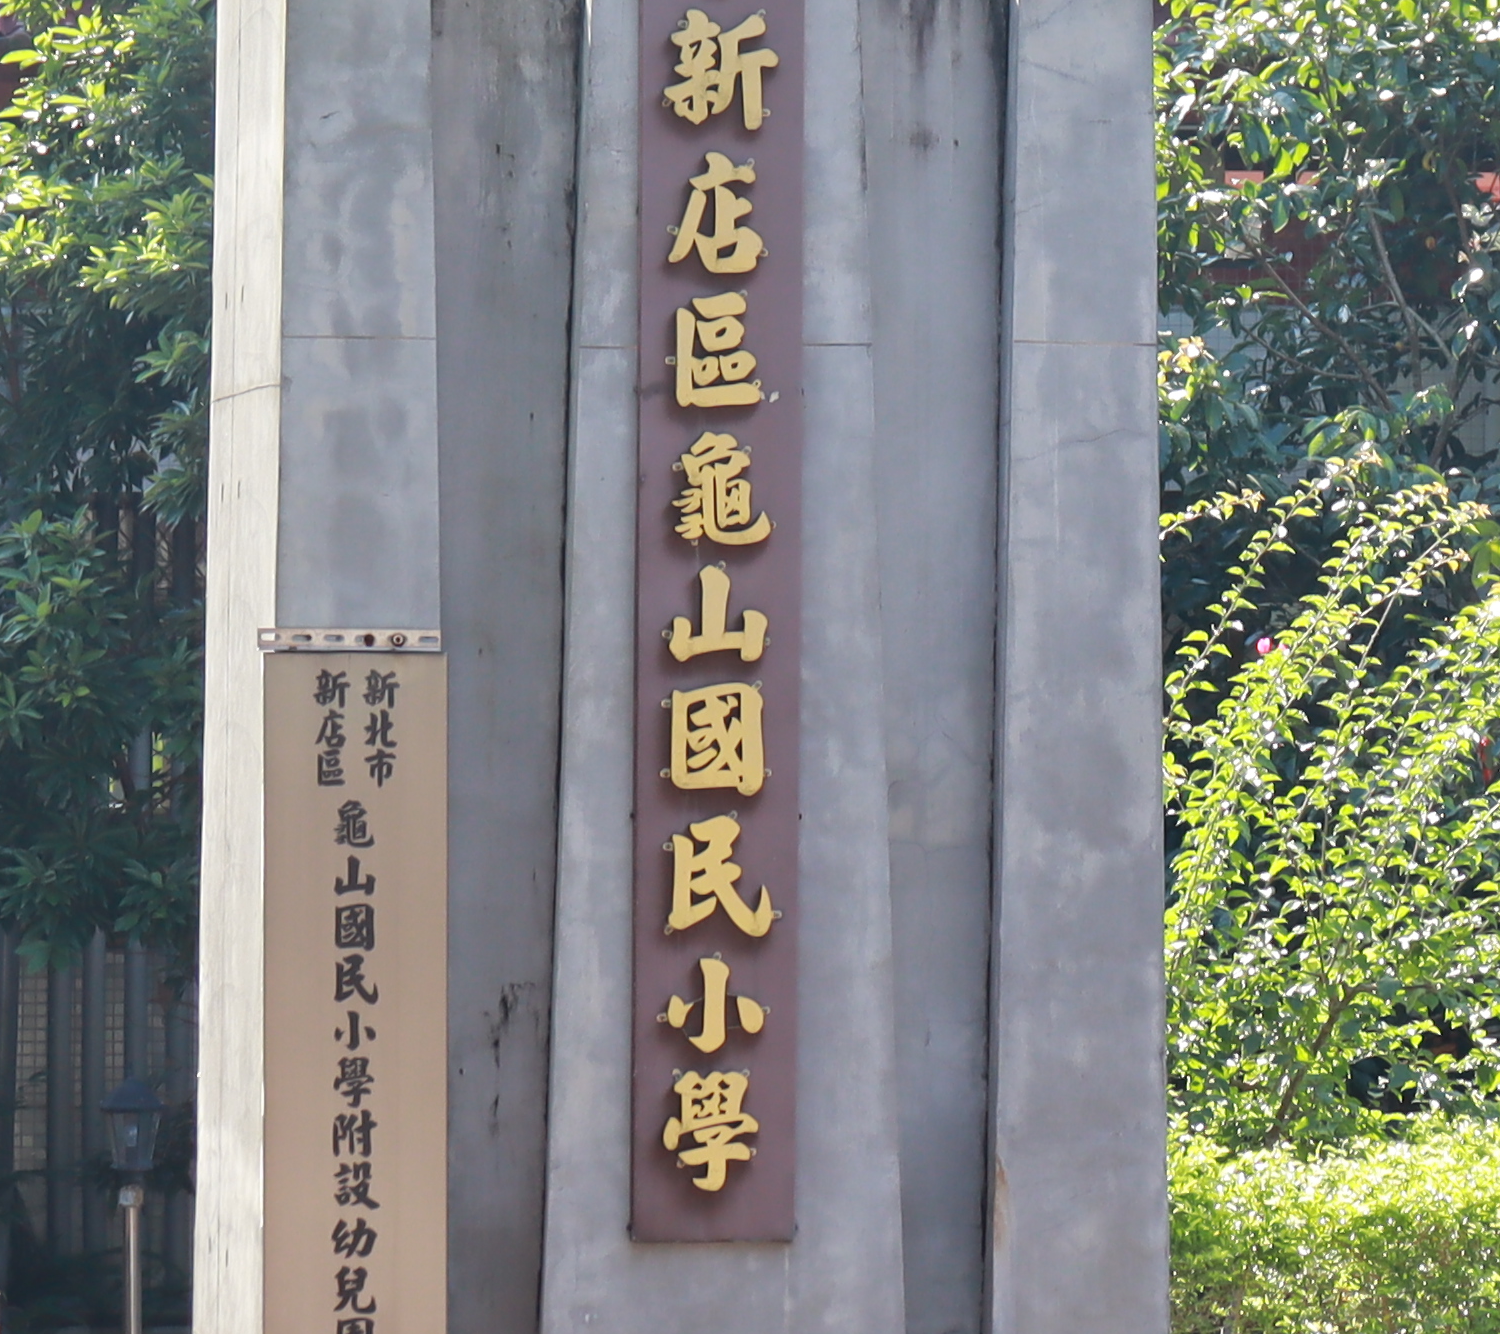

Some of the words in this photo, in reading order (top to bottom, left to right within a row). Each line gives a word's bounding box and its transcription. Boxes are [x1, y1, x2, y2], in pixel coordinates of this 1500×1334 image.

[313, 668, 350, 787] 新店區
[362, 668, 400, 788] 新北市
